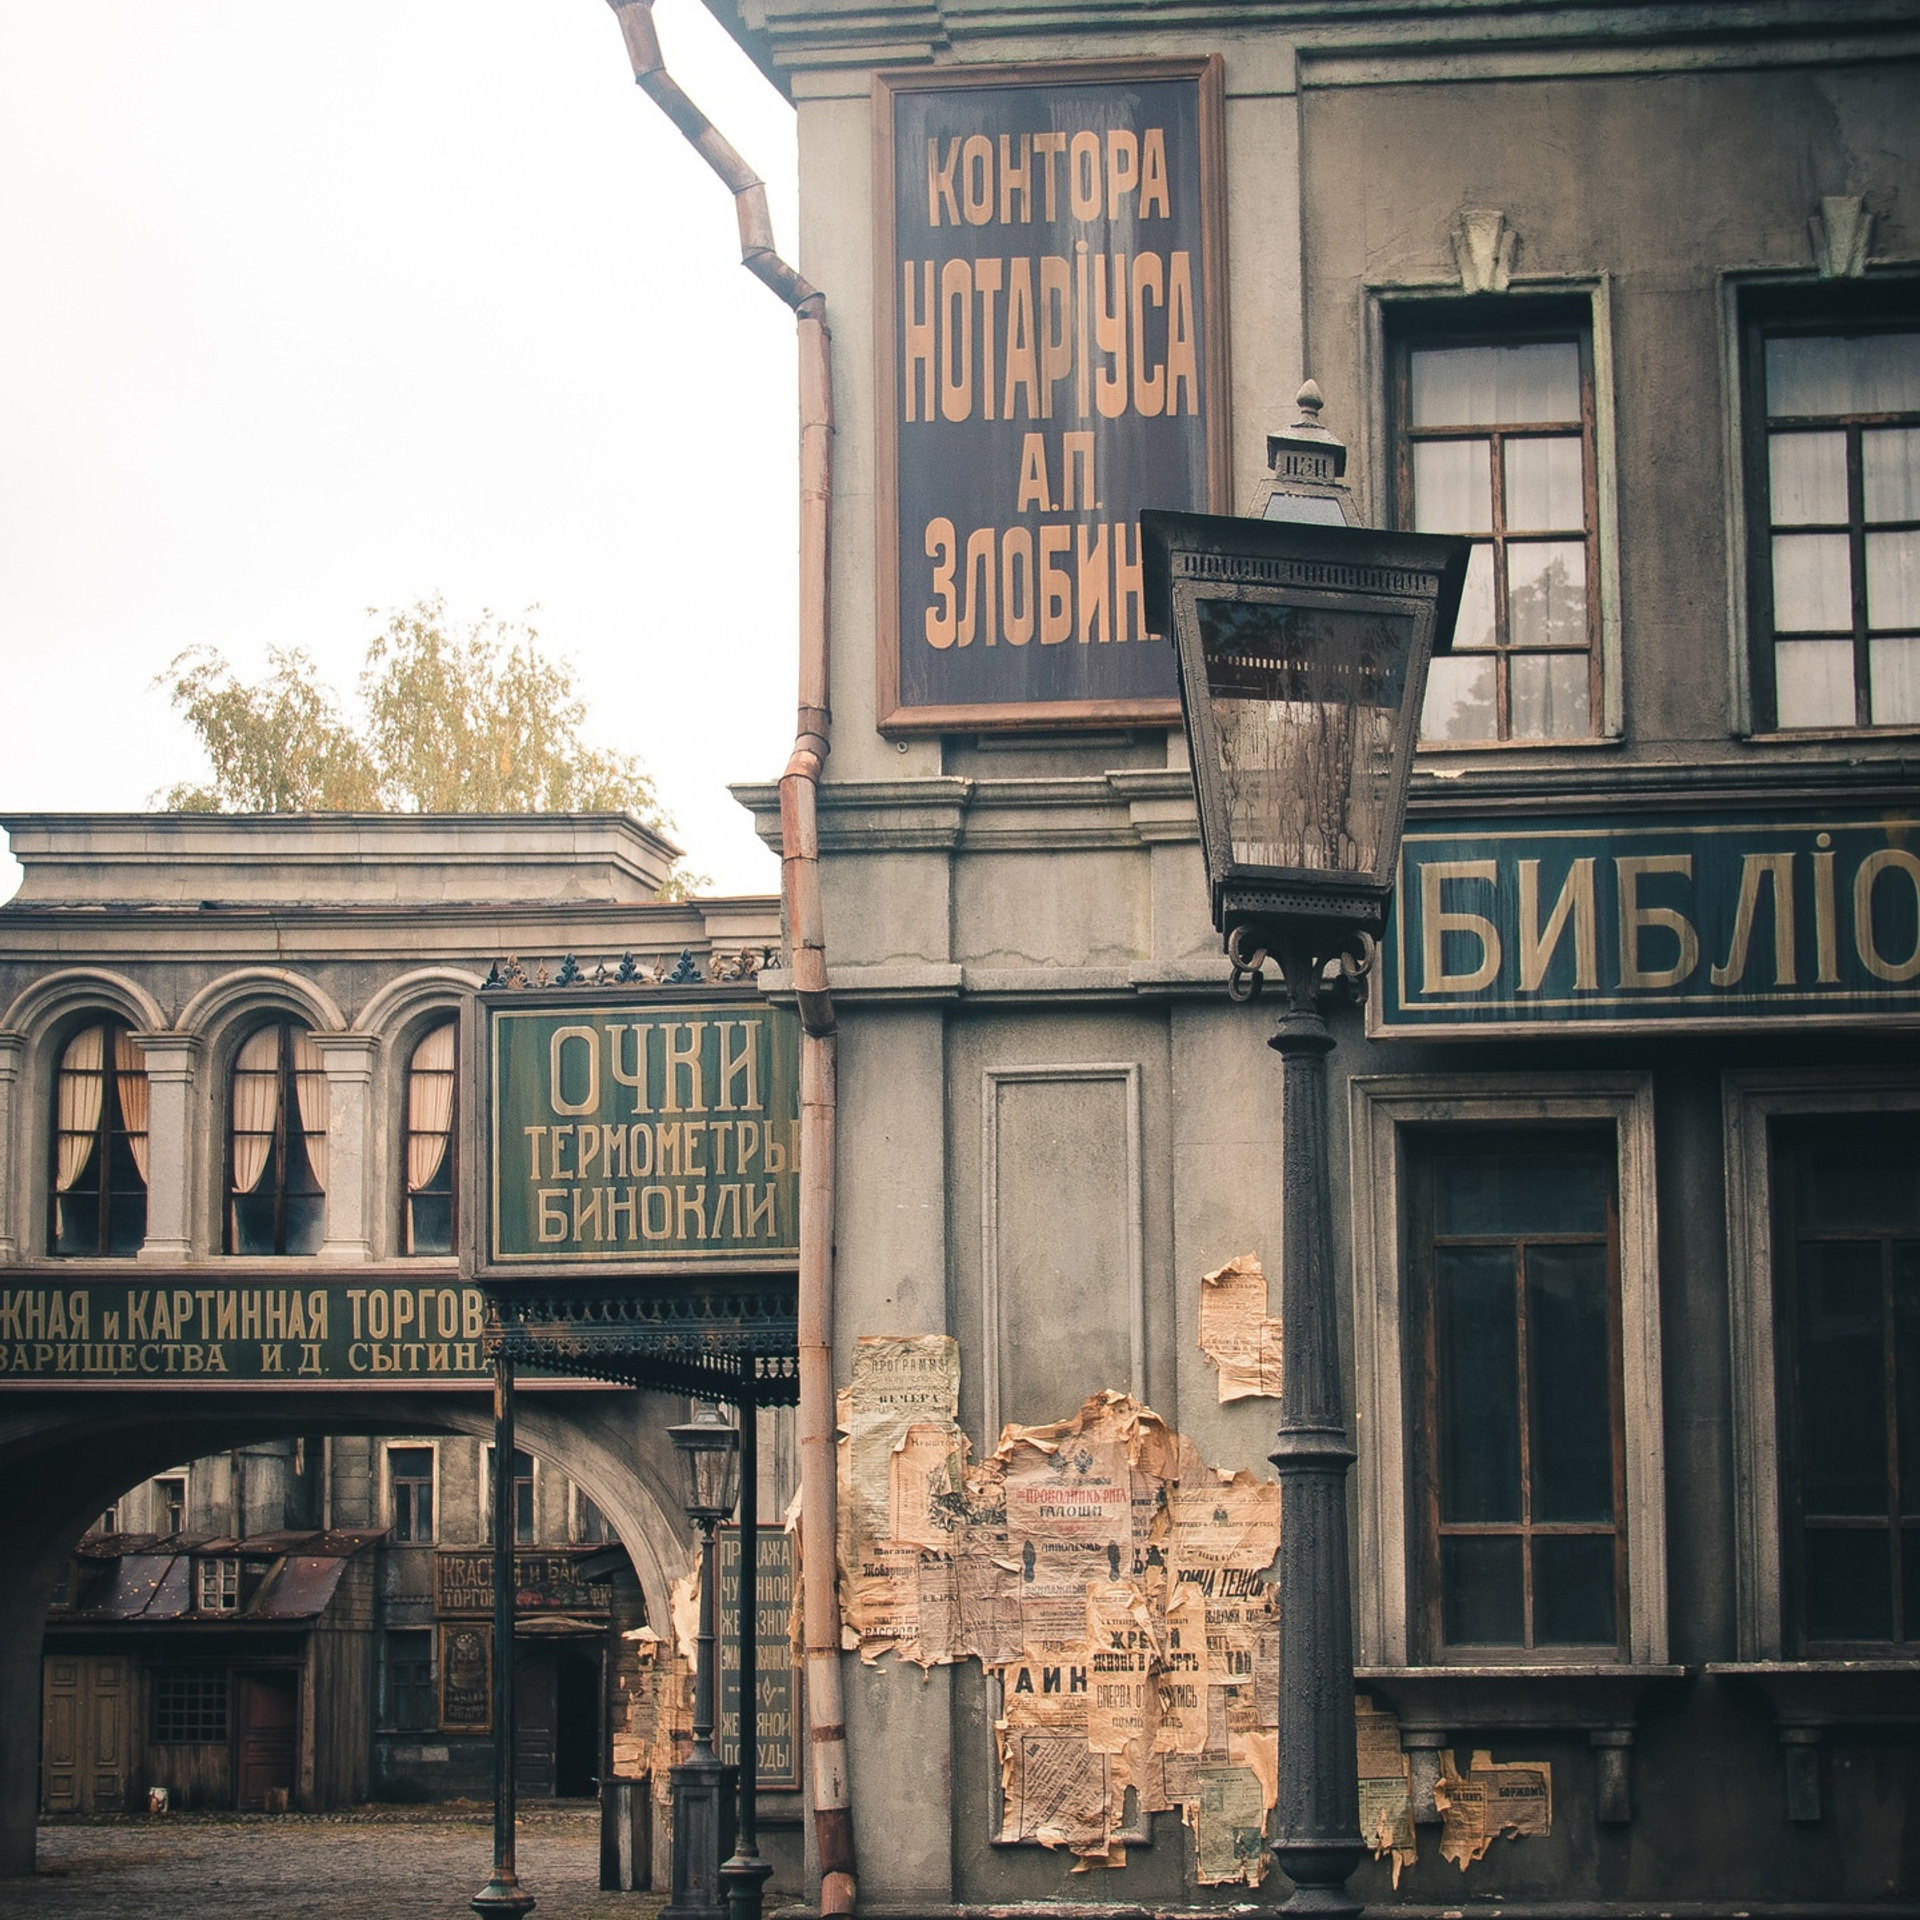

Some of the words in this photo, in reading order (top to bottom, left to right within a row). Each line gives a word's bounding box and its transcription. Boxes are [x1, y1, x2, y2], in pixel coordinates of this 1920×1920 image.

[928, 129, 1170, 226] КОНТОРА
[904, 241, 1198, 422] НОТАРІУСА
[925, 517, 1161, 649] ЗЛОБИН
[1418, 833, 1920, 993] БИБЛІО
[550, 1020, 763, 1116] ОЧКИ
[524, 1120, 799, 1180] ТЕРМОМЕТРЫ
[538, 1183, 777, 1243] БИНОКЛИ
[128, 1290, 328, 1340] КАРТИННАЯ
[347, 1288, 484, 1340] ТОРГОВ
[722, 1540, 791, 1568] ПРАЖА
[721, 1574, 791, 1602] ЧУННОЙ
[721, 1607, 792, 1636] ЖЕЗНОЙ
[1110, 1628, 1180, 1649] ЖРЕЙ
[722, 1708, 791, 1737] ЖЕЯНОЙ
[725, 1743, 790, 1771] ПОУДЫ
